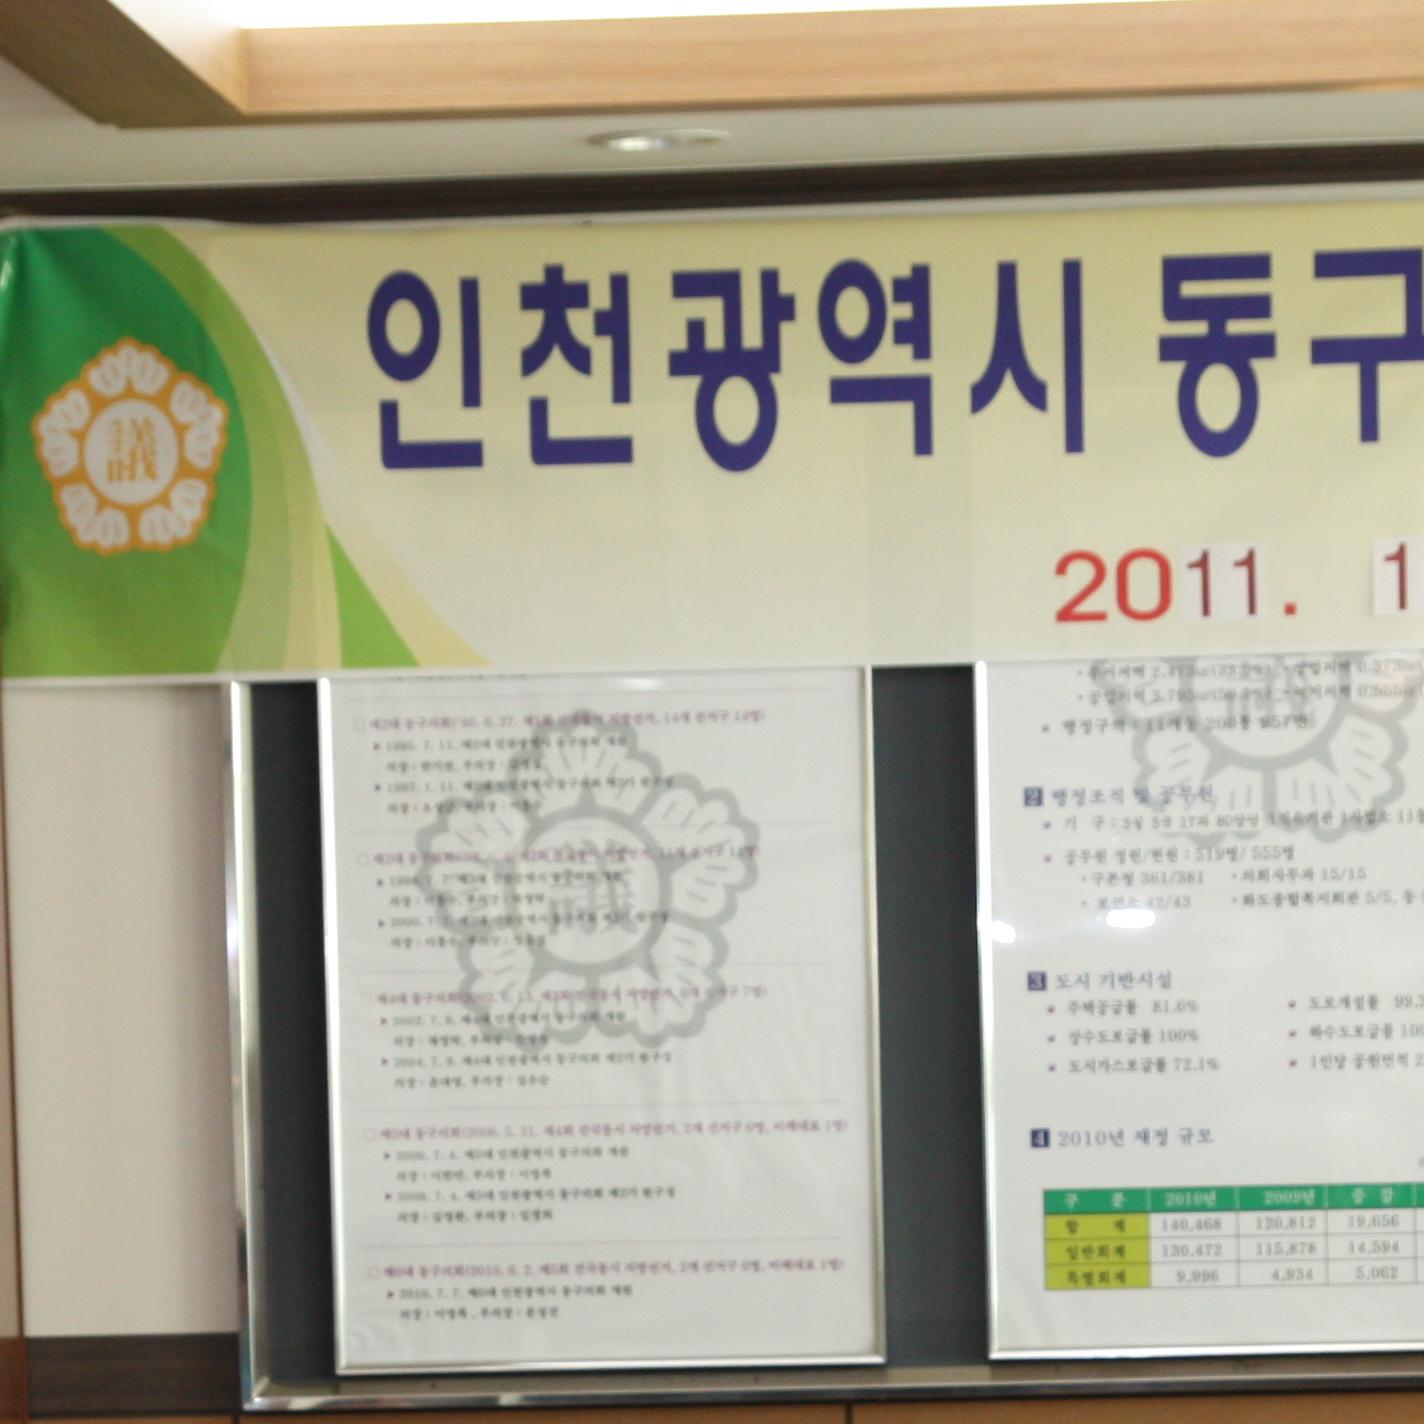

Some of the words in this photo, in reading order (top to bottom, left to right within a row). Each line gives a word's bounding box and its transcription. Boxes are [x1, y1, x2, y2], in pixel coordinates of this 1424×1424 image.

[367, 257, 1085, 472] 인천광역시
[1053, 547, 1299, 623] 2011.
[1054, 972, 1090, 990] 도시
[1099, 970, 1173, 990] 기반시설
[1159, 1028, 1201, 1043] 100%
[1057, 1129, 1124, 1147] 2010년
[1178, 1128, 1215, 1145] 규모
